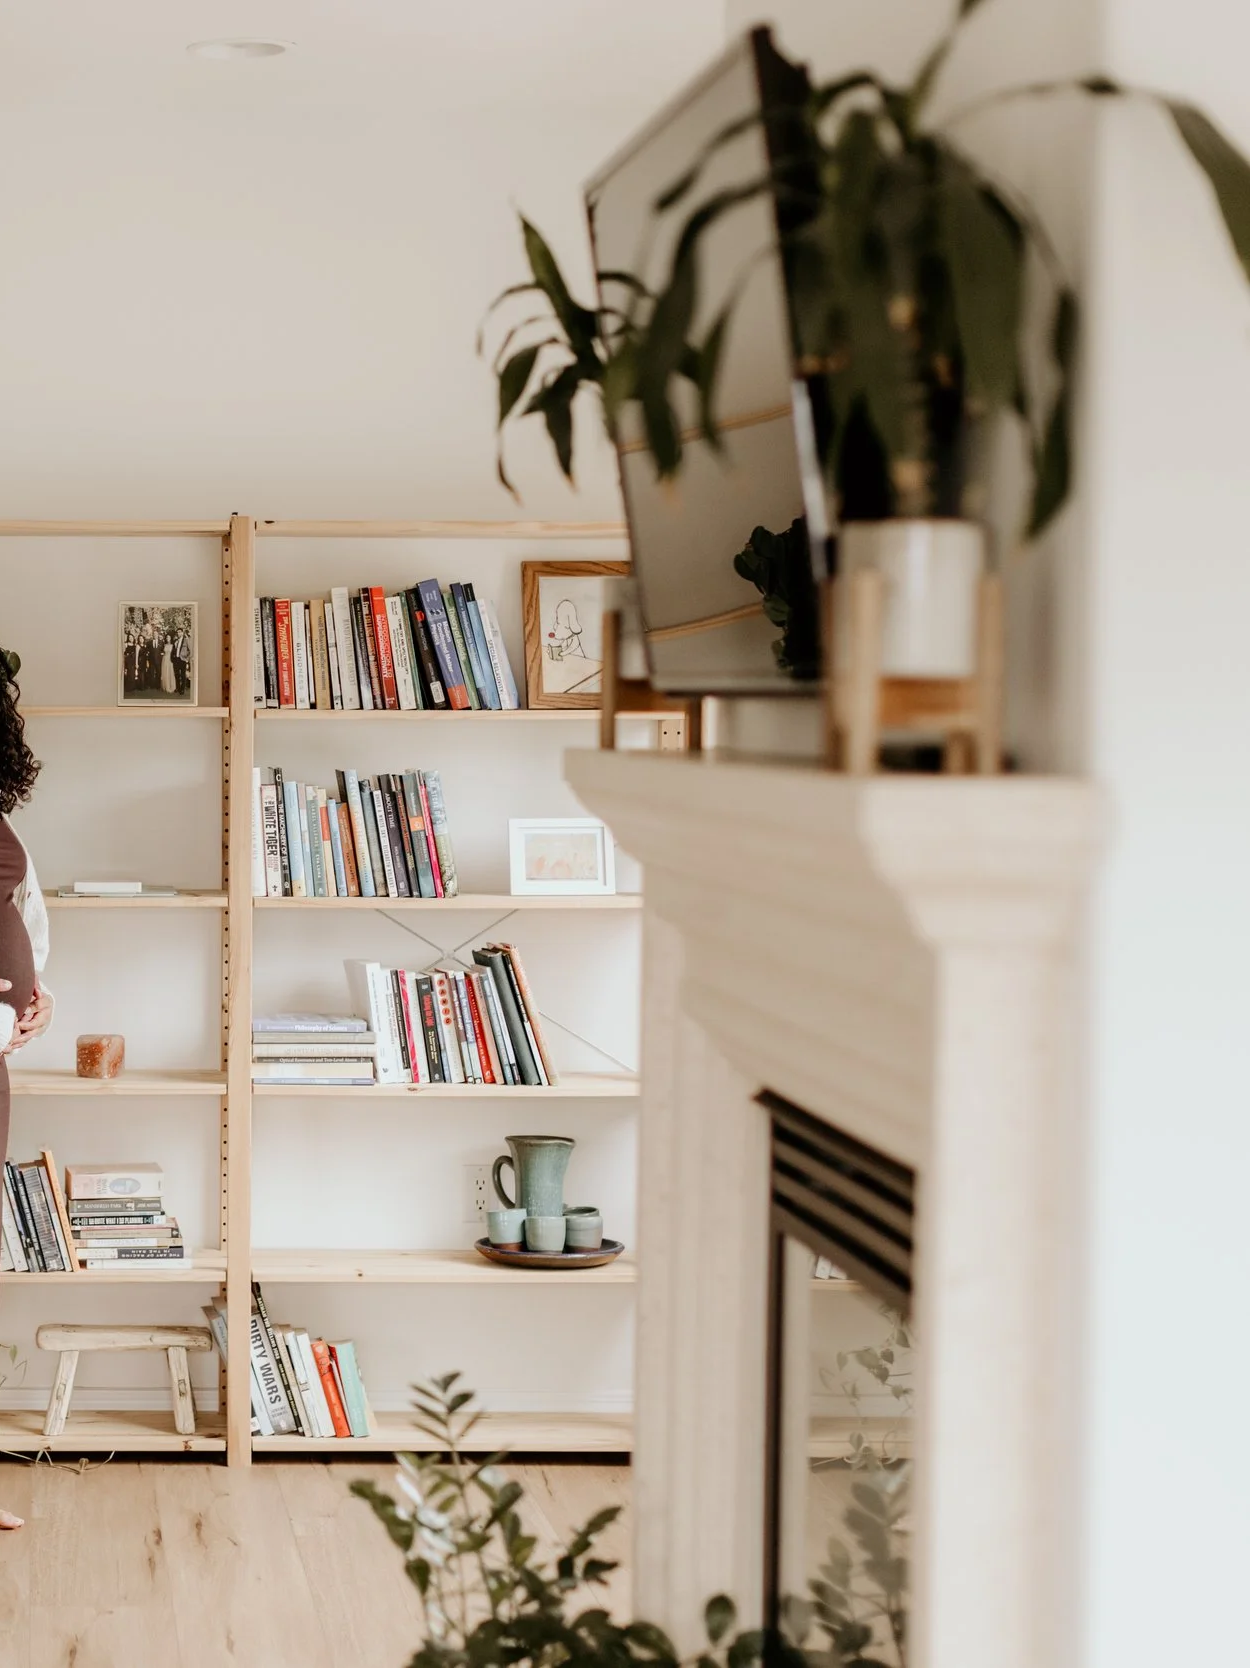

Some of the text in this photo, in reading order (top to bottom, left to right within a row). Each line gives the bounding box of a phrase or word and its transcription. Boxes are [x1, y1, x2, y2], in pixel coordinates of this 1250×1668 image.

[342, 618, 356, 686] MANUFACTURING CONSENT
[374, 614, 389, 678] SUPERCONDUCTIVITY
[379, 614, 393, 677] INTRODUCTION TO
[429, 623, 440, 645] Physics
[436, 622, 454, 672] Condensed Matter
[442, 620, 452, 642] Modern
[447, 607, 460, 631] Theory
[456, 638, 467, 660] Solids
[295, 642, 304, 690] BLINDNESS
[486, 638, 506, 693] SPECIAL RELATIVITY
[264, 805, 278, 856] WHITE TIGER
[278, 814, 286, 844] MACHINERY
[384, 792, 395, 828] ABOUT TIME
[280, 846, 286, 854] OF
[424, 1016, 434, 1027] Light
[462, 1006, 470, 1022] record
[256, 1296, 280, 1359] BATMAN THE KILLING JOKE
[251, 1318, 282, 1404] DIRTY WARS
